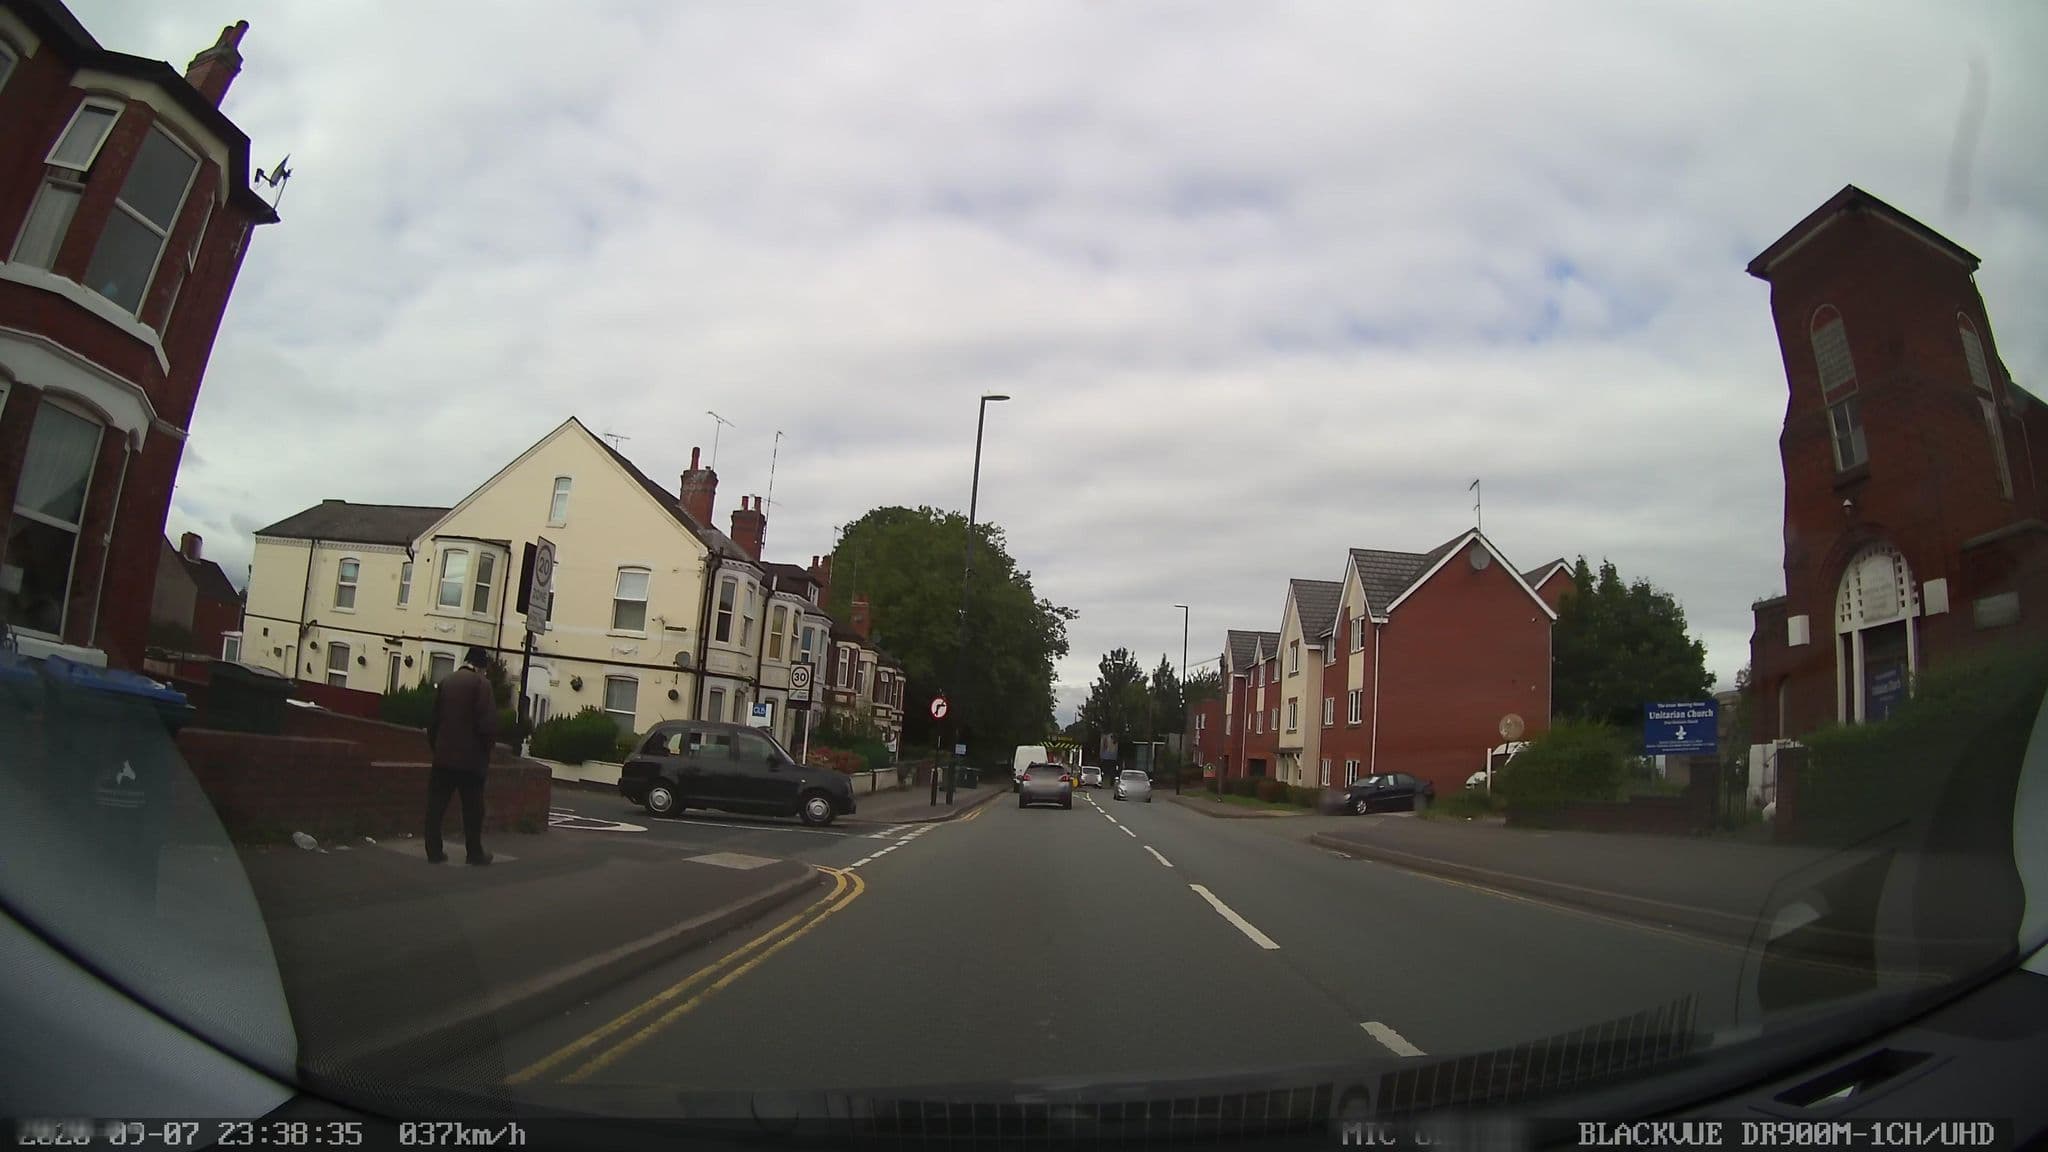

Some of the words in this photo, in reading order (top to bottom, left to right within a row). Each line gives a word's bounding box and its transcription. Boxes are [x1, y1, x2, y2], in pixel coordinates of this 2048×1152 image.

[538, 556, 550, 576] 20
[794, 672, 806, 682] 30
[1649, 710, 1686, 720] Unitarian
[1687, 708, 1714, 718] Church
